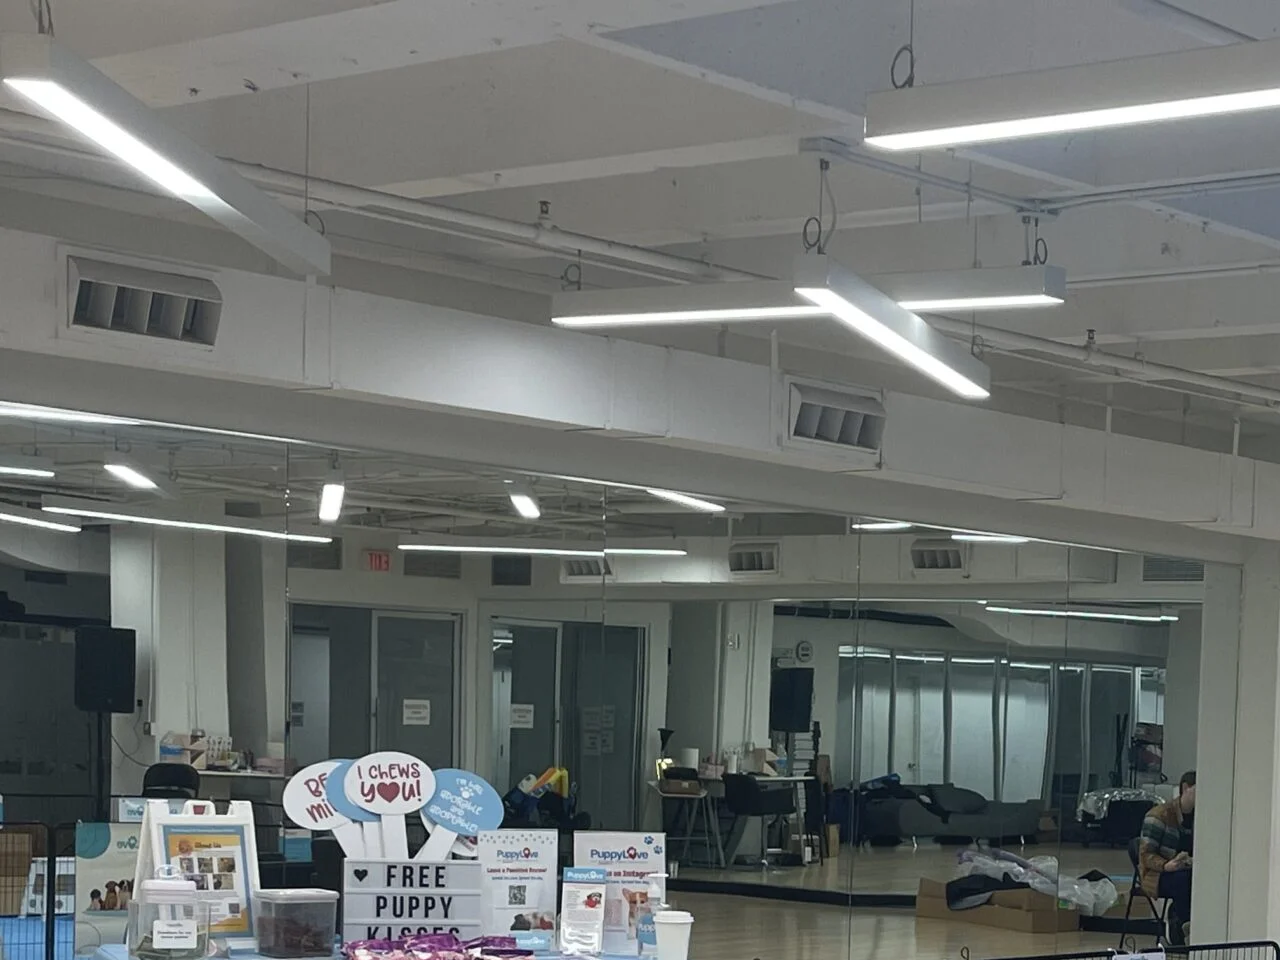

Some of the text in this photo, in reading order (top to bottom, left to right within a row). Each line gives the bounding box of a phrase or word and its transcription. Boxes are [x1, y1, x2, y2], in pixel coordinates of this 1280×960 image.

[590, 846, 649, 861] PuppyLove
[386, 865, 446, 888] FREE
[375, 896, 453, 919] PUPPY
